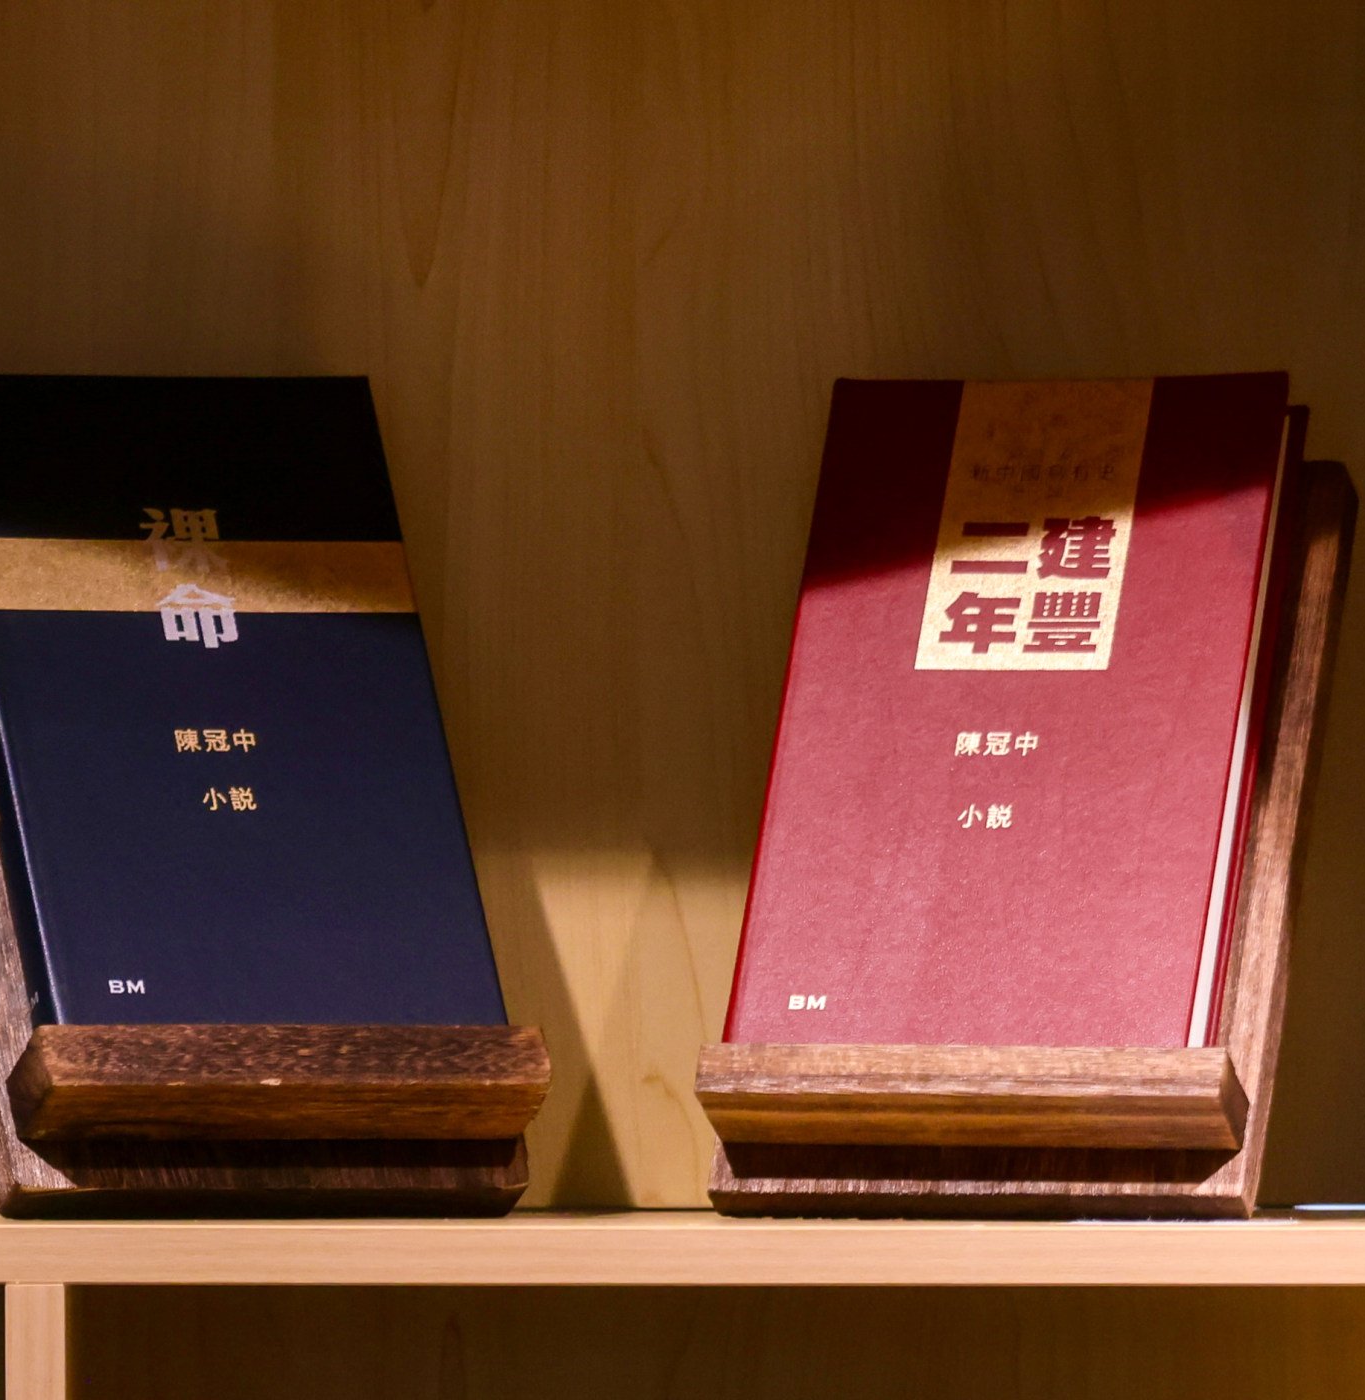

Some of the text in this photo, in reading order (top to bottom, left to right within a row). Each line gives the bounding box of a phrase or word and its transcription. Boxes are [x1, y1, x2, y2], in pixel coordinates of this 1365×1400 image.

[174, 728, 257, 753] 陳冠中
[954, 731, 1039, 757] 陳冠中
[108, 979, 146, 995] BM
[787, 995, 827, 1011] BM
